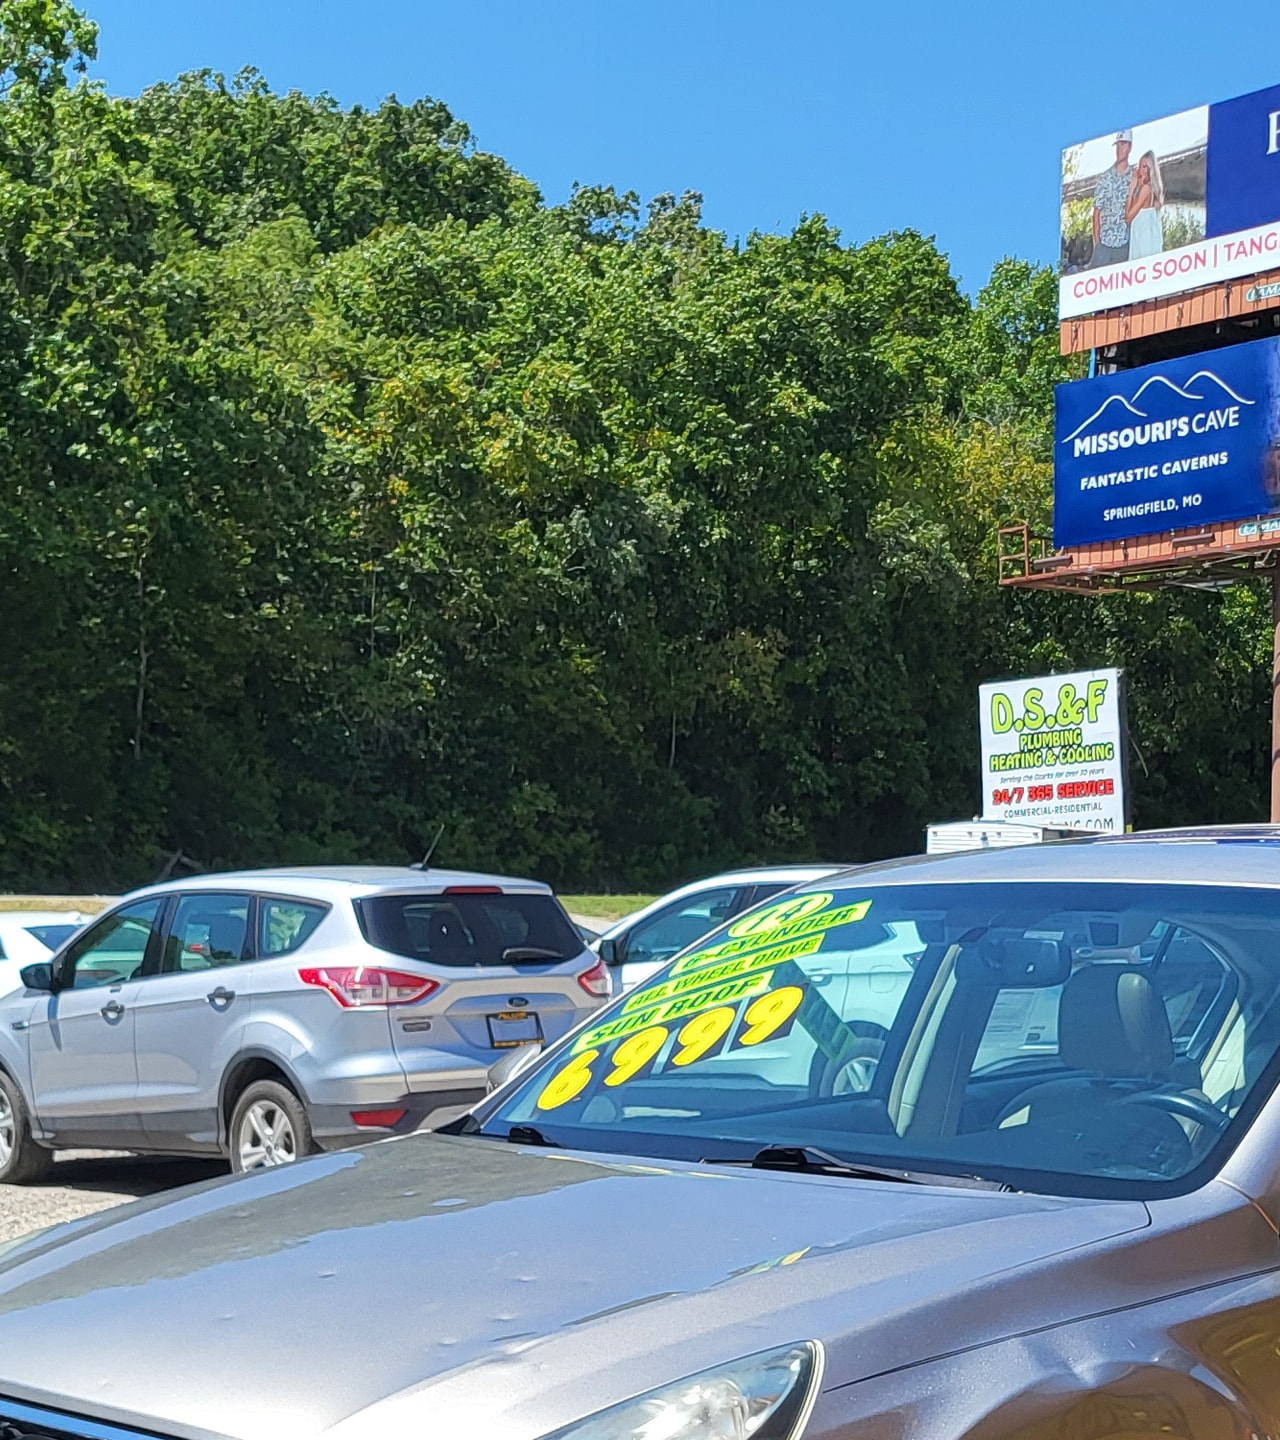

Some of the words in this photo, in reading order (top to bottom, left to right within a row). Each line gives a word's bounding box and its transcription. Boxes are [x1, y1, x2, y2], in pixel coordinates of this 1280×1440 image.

[1073, 267, 1147, 299] COMING
[1152, 251, 1208, 281] SOON
[1073, 416, 1189, 457] MISSOURI'S
[1192, 406, 1240, 434] CAVE
[1080, 464, 1158, 490] FANTASTIC
[1162, 451, 1228, 475] CAVERNS
[1103, 498, 1179, 521] SPRINGFIELD,
[1182, 493, 1202, 508] MO
[990, 750, 1042, 772] HEATING
[1044, 747, 1057, 766] &
[1059, 742, 1114, 765] COOLING
[1019, 727, 1082, 751] PLUMBING
[992, 787, 1024, 806] 24/7
[1027, 784, 1053, 802] 365
[1057, 778, 1114, 799] SERVICE
[631, 986, 666, 1010] ALL
[672, 963, 744, 992] WHEEL
[750, 937, 818, 968] DRIVE
[586, 1007, 657, 1046] SUN
[663, 976, 766, 1020] ROOF
[538, 986, 804, 1110] 6999
